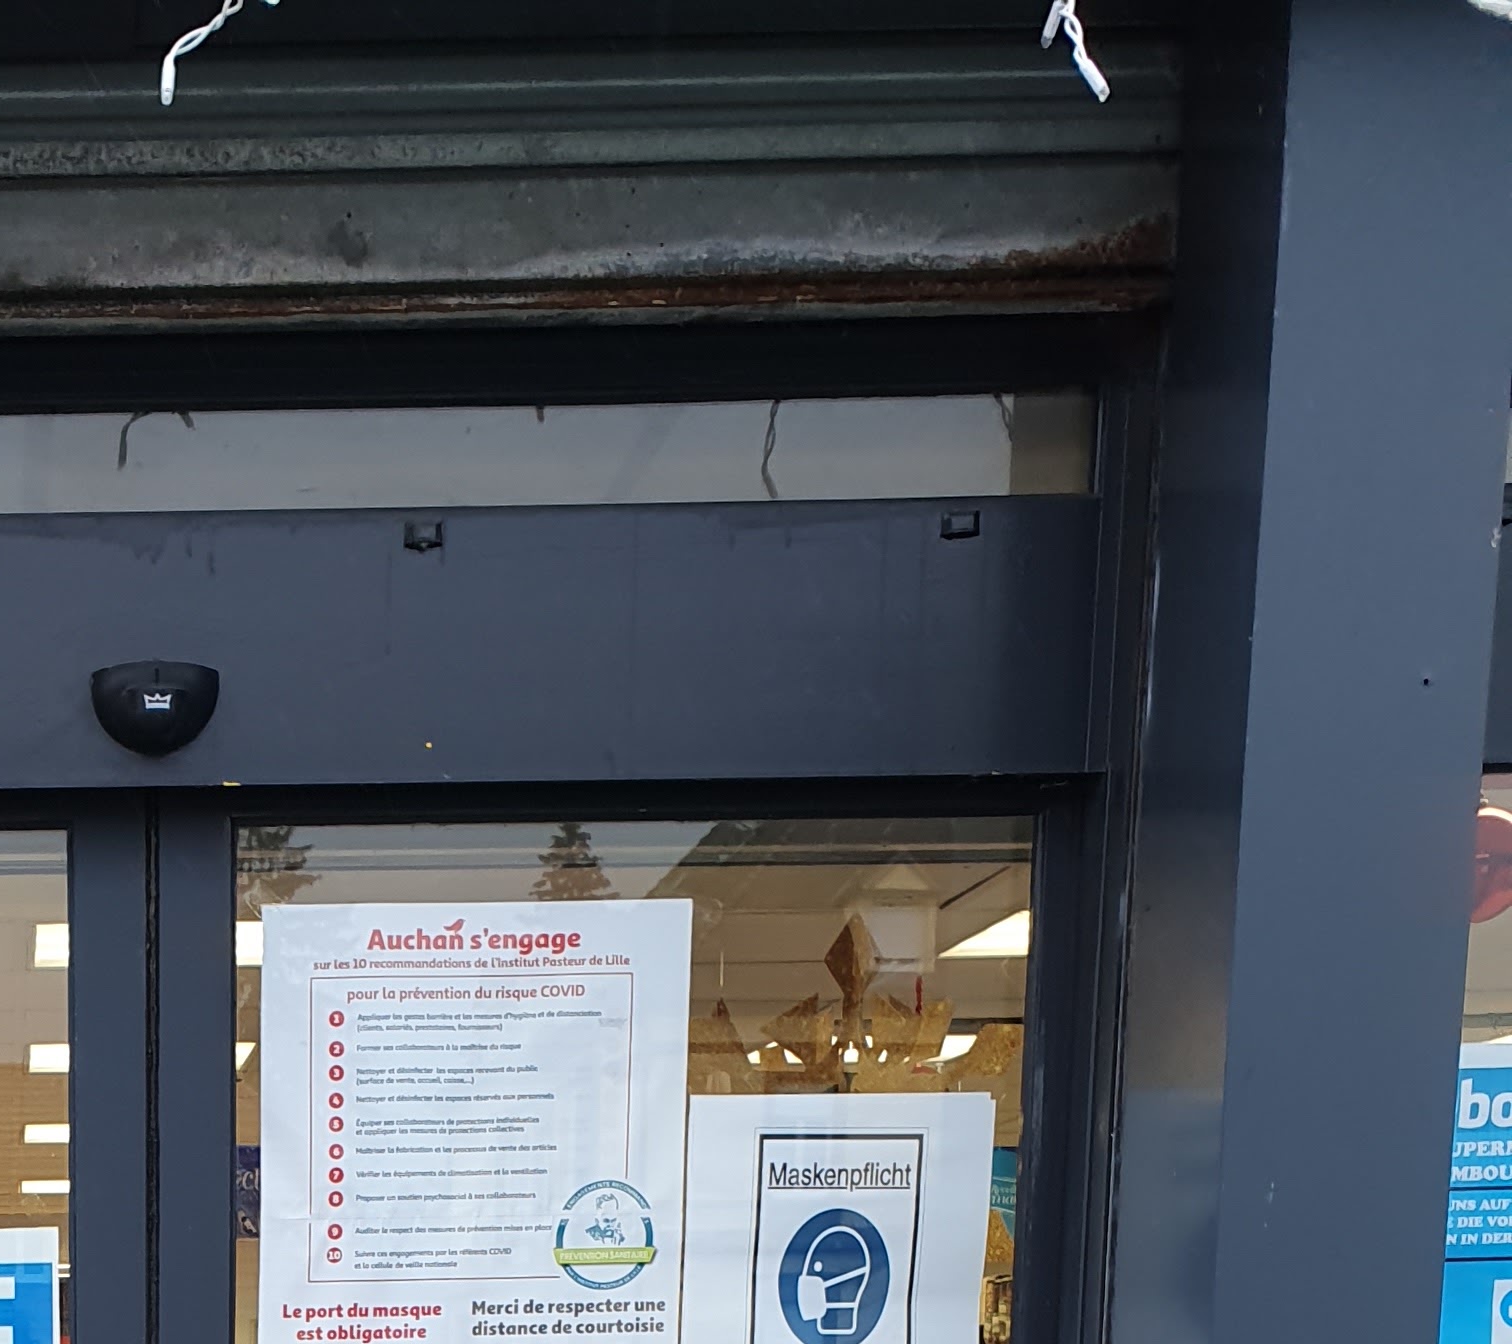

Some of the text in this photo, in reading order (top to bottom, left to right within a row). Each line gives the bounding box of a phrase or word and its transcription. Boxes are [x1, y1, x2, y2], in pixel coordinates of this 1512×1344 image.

[367, 928, 581, 954] Auchan s'engage
[313, 961, 331, 970] sur
[334, 959, 350, 969] les
[353, 958, 366, 969] 10
[369, 957, 471, 969] recommandations
[474, 958, 488, 968] de
[542, 956, 586, 967] Pasteur
[589, 955, 603, 965] de
[605, 954, 631, 965] Lille
[347, 984, 585, 1004] pour la prévention du risque COVID
[768, 1162, 911, 1192] Maskenpflicht
[283, 1304, 442, 1322] Le port du masque
[472, 1299, 666, 1317] Merci de respecter une
[297, 1325, 427, 1344] est obligatoire
[472, 1319, 665, 1336] distance de courtoisie
